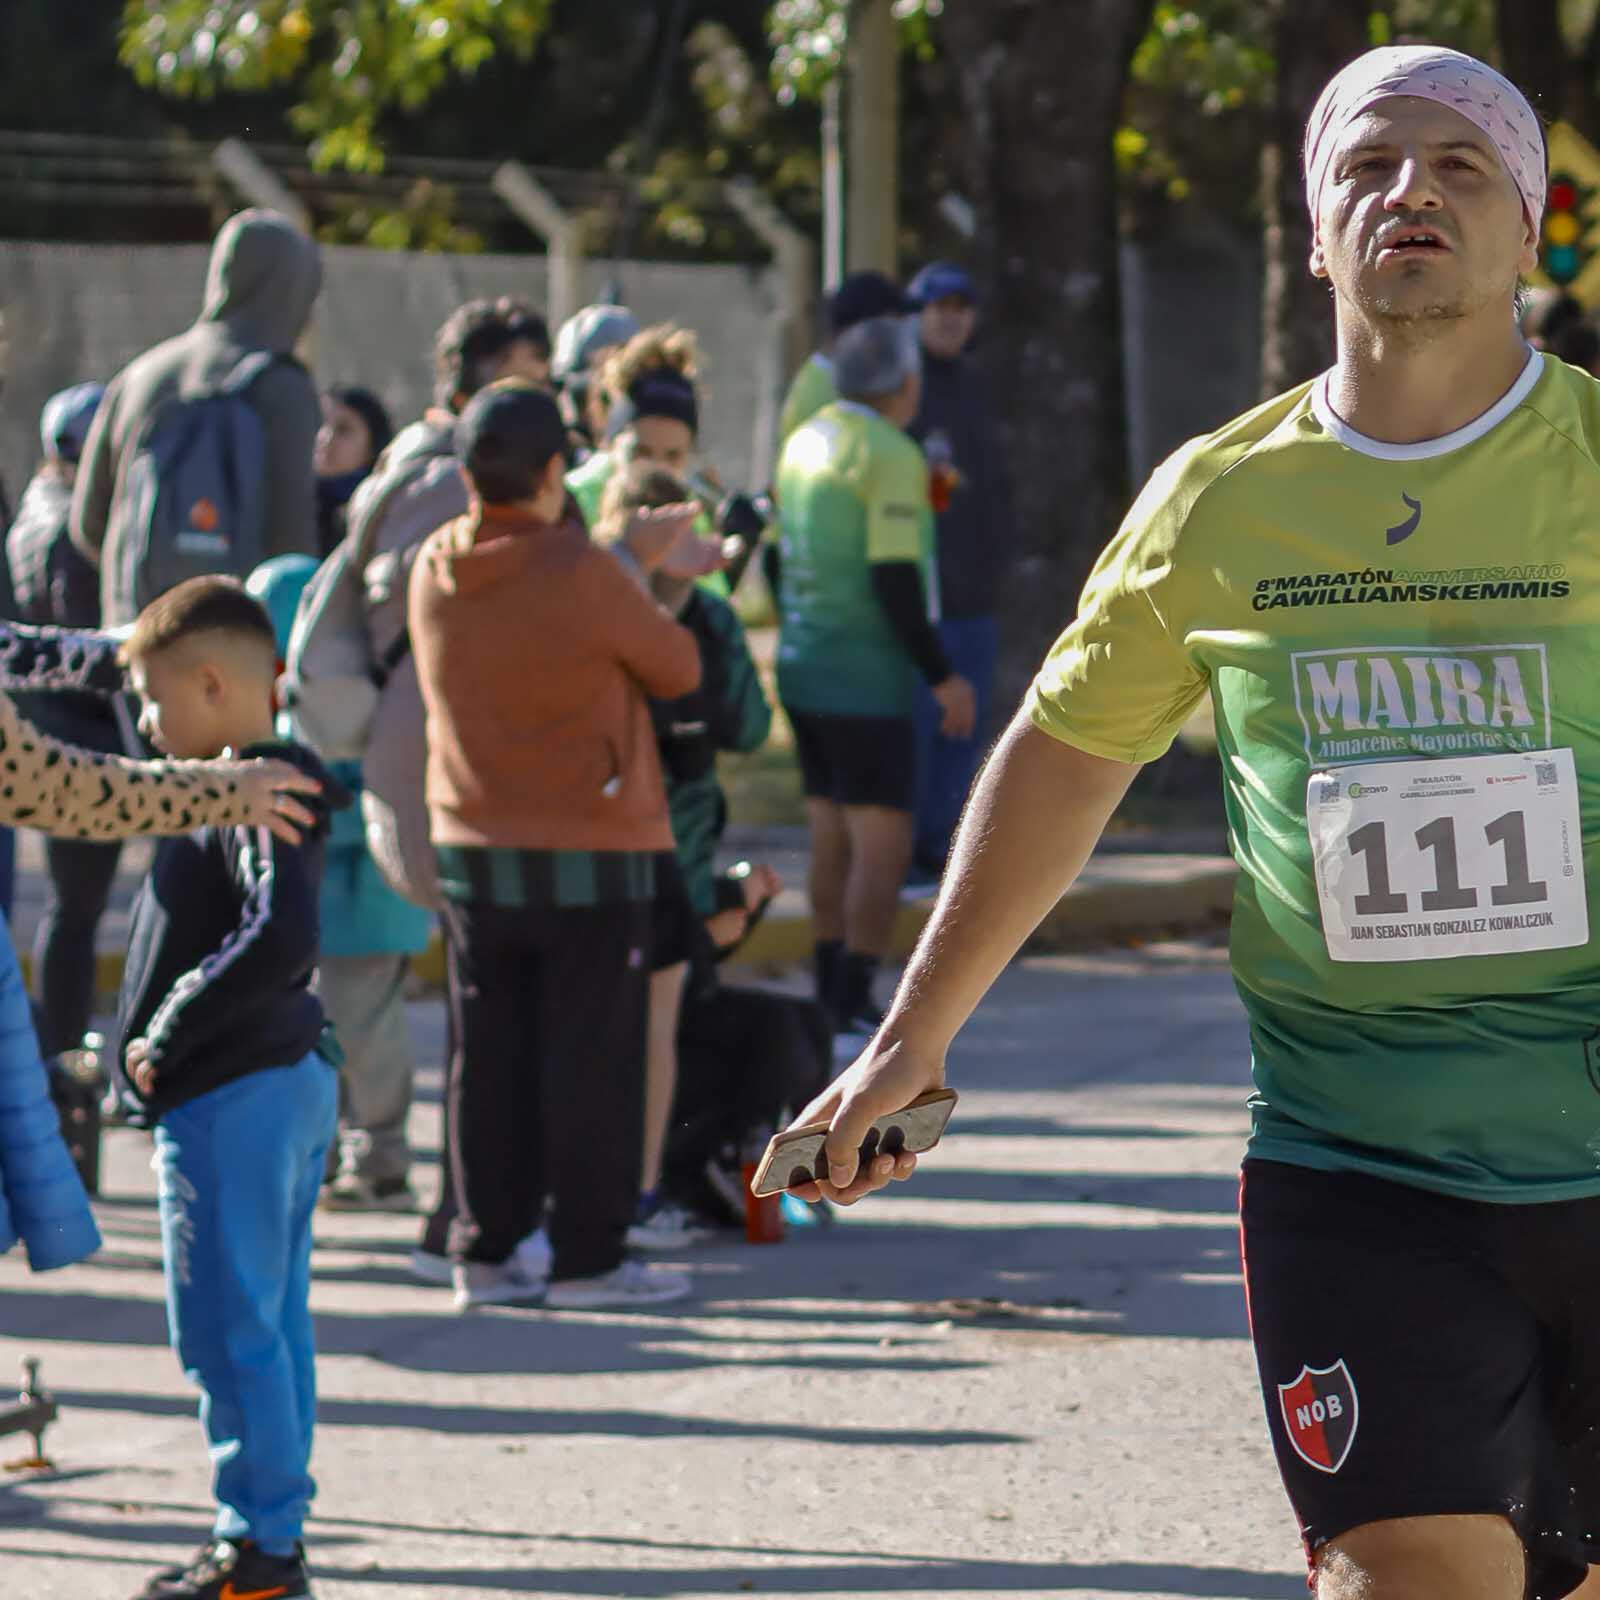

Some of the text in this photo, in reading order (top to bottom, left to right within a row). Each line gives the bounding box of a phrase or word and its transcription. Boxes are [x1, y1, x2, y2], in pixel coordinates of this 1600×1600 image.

[1252, 581, 1570, 611] CAWILLIAMSKEMMIS
[1305, 656, 1535, 734] MAIRA
[1409, 731, 1502, 752] Mayoristas
[1347, 811, 1548, 915] 111
[1351, 912, 1554, 940] JUAN SEBASTIAN GONZALEZ KOWALCZUK
[1296, 1395, 1342, 1430] NOB
